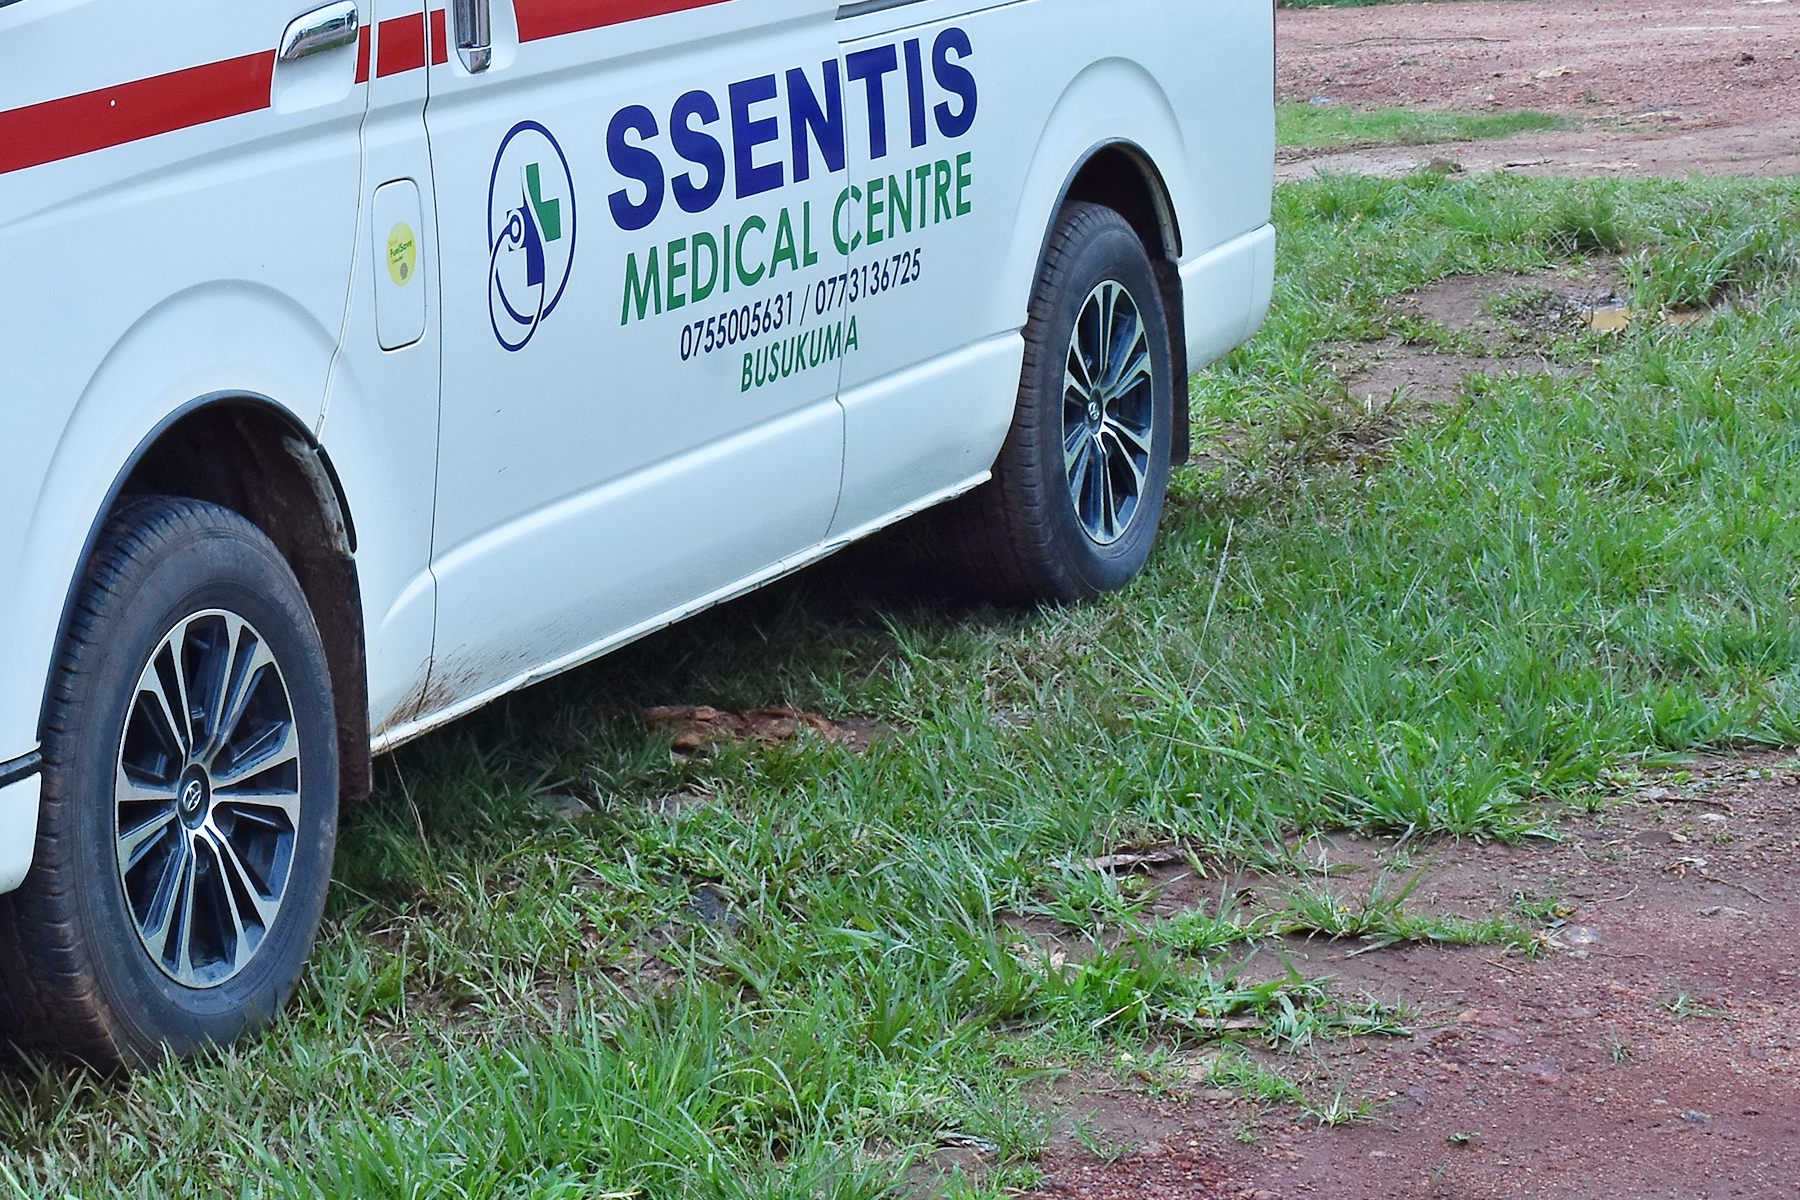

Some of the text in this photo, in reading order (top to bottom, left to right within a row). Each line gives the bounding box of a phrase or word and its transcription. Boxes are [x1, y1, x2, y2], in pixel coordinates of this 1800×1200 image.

[605, 26, 978, 231] SSENTIS
[620, 151, 972, 326] MEDICAL CENTRE
[679, 291, 795, 362] 0755005631
[815, 248, 922, 311] 0773136725
[741, 315, 859, 393] BUSUKUMA
